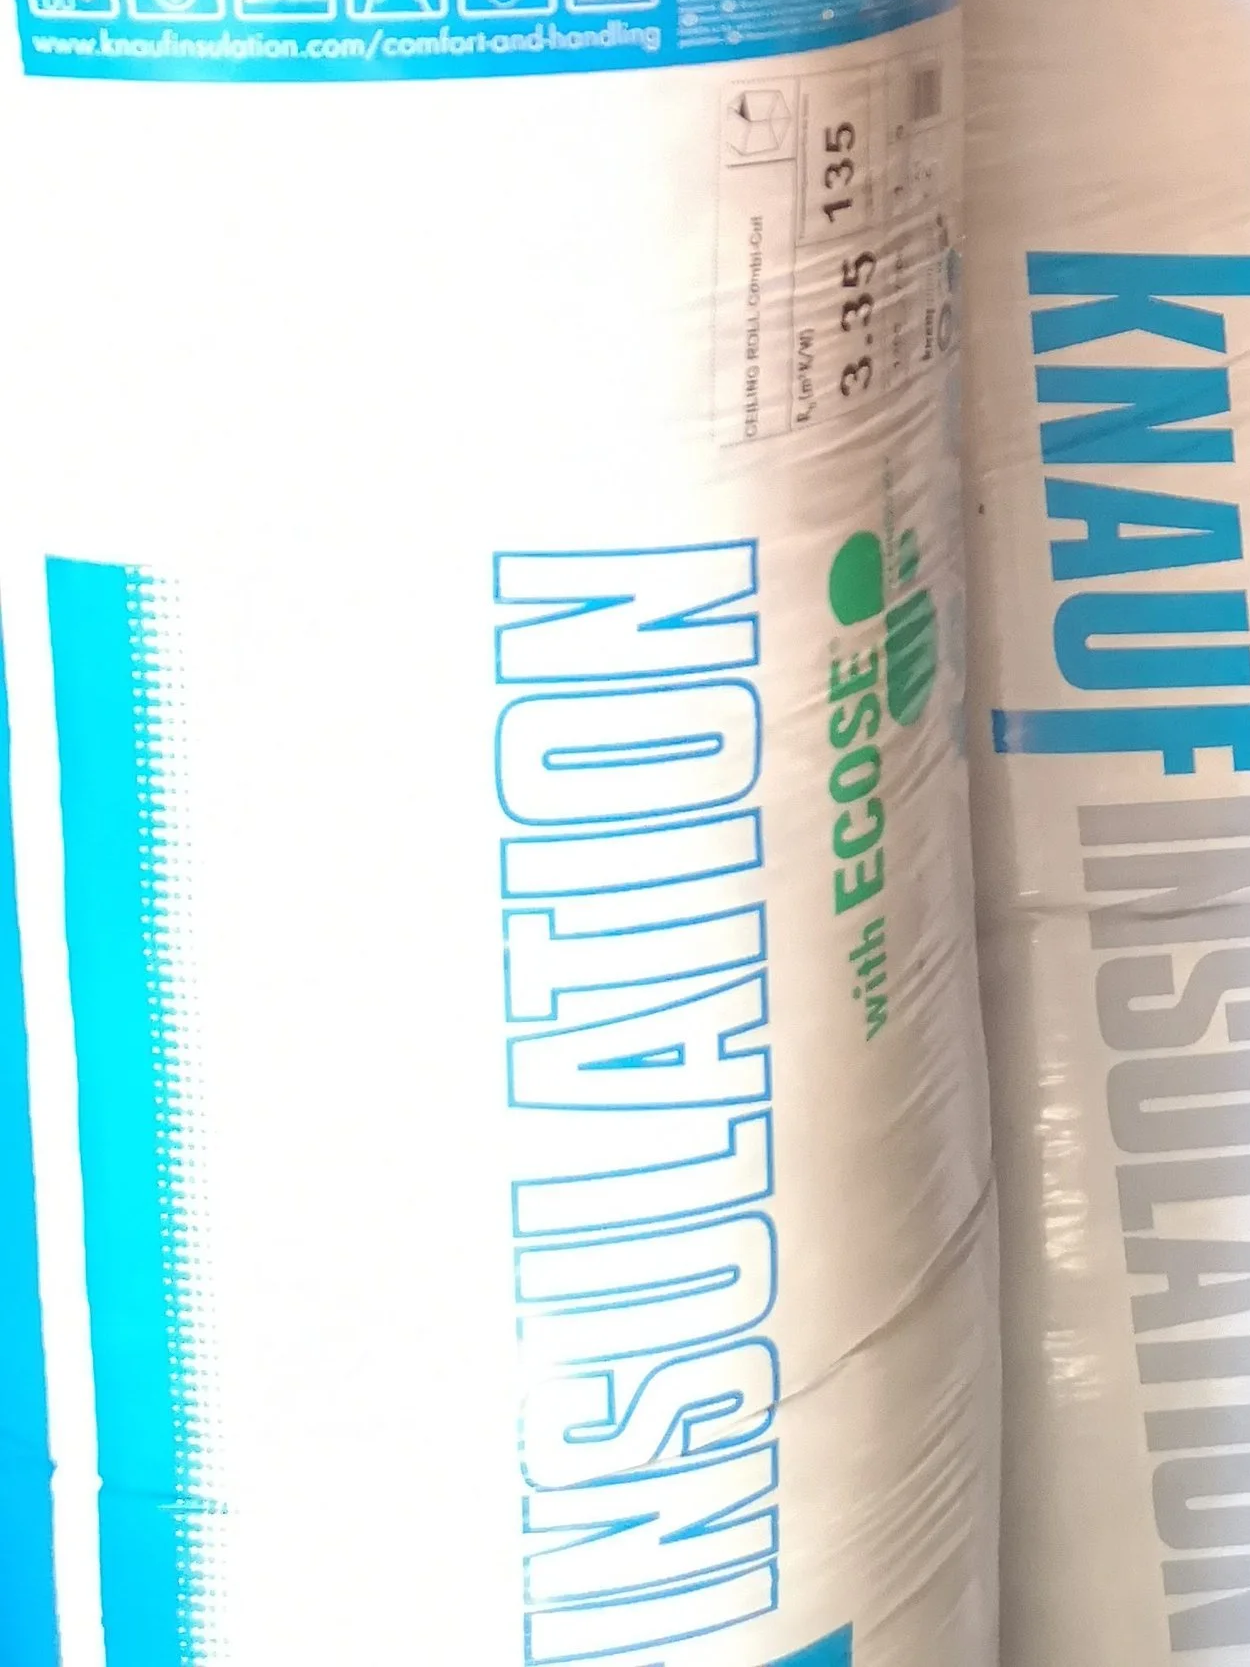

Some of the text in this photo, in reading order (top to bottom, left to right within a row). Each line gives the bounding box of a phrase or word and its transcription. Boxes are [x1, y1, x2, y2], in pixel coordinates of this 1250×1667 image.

[820, 121, 856, 224] 135
[744, 311, 761, 359] ROLL
[839, 250, 877, 398] 3.35
[743, 363, 761, 438] CEILING
[827, 645, 888, 1042] with ECOSE
[492, 537, 780, 1667] INSULATION
